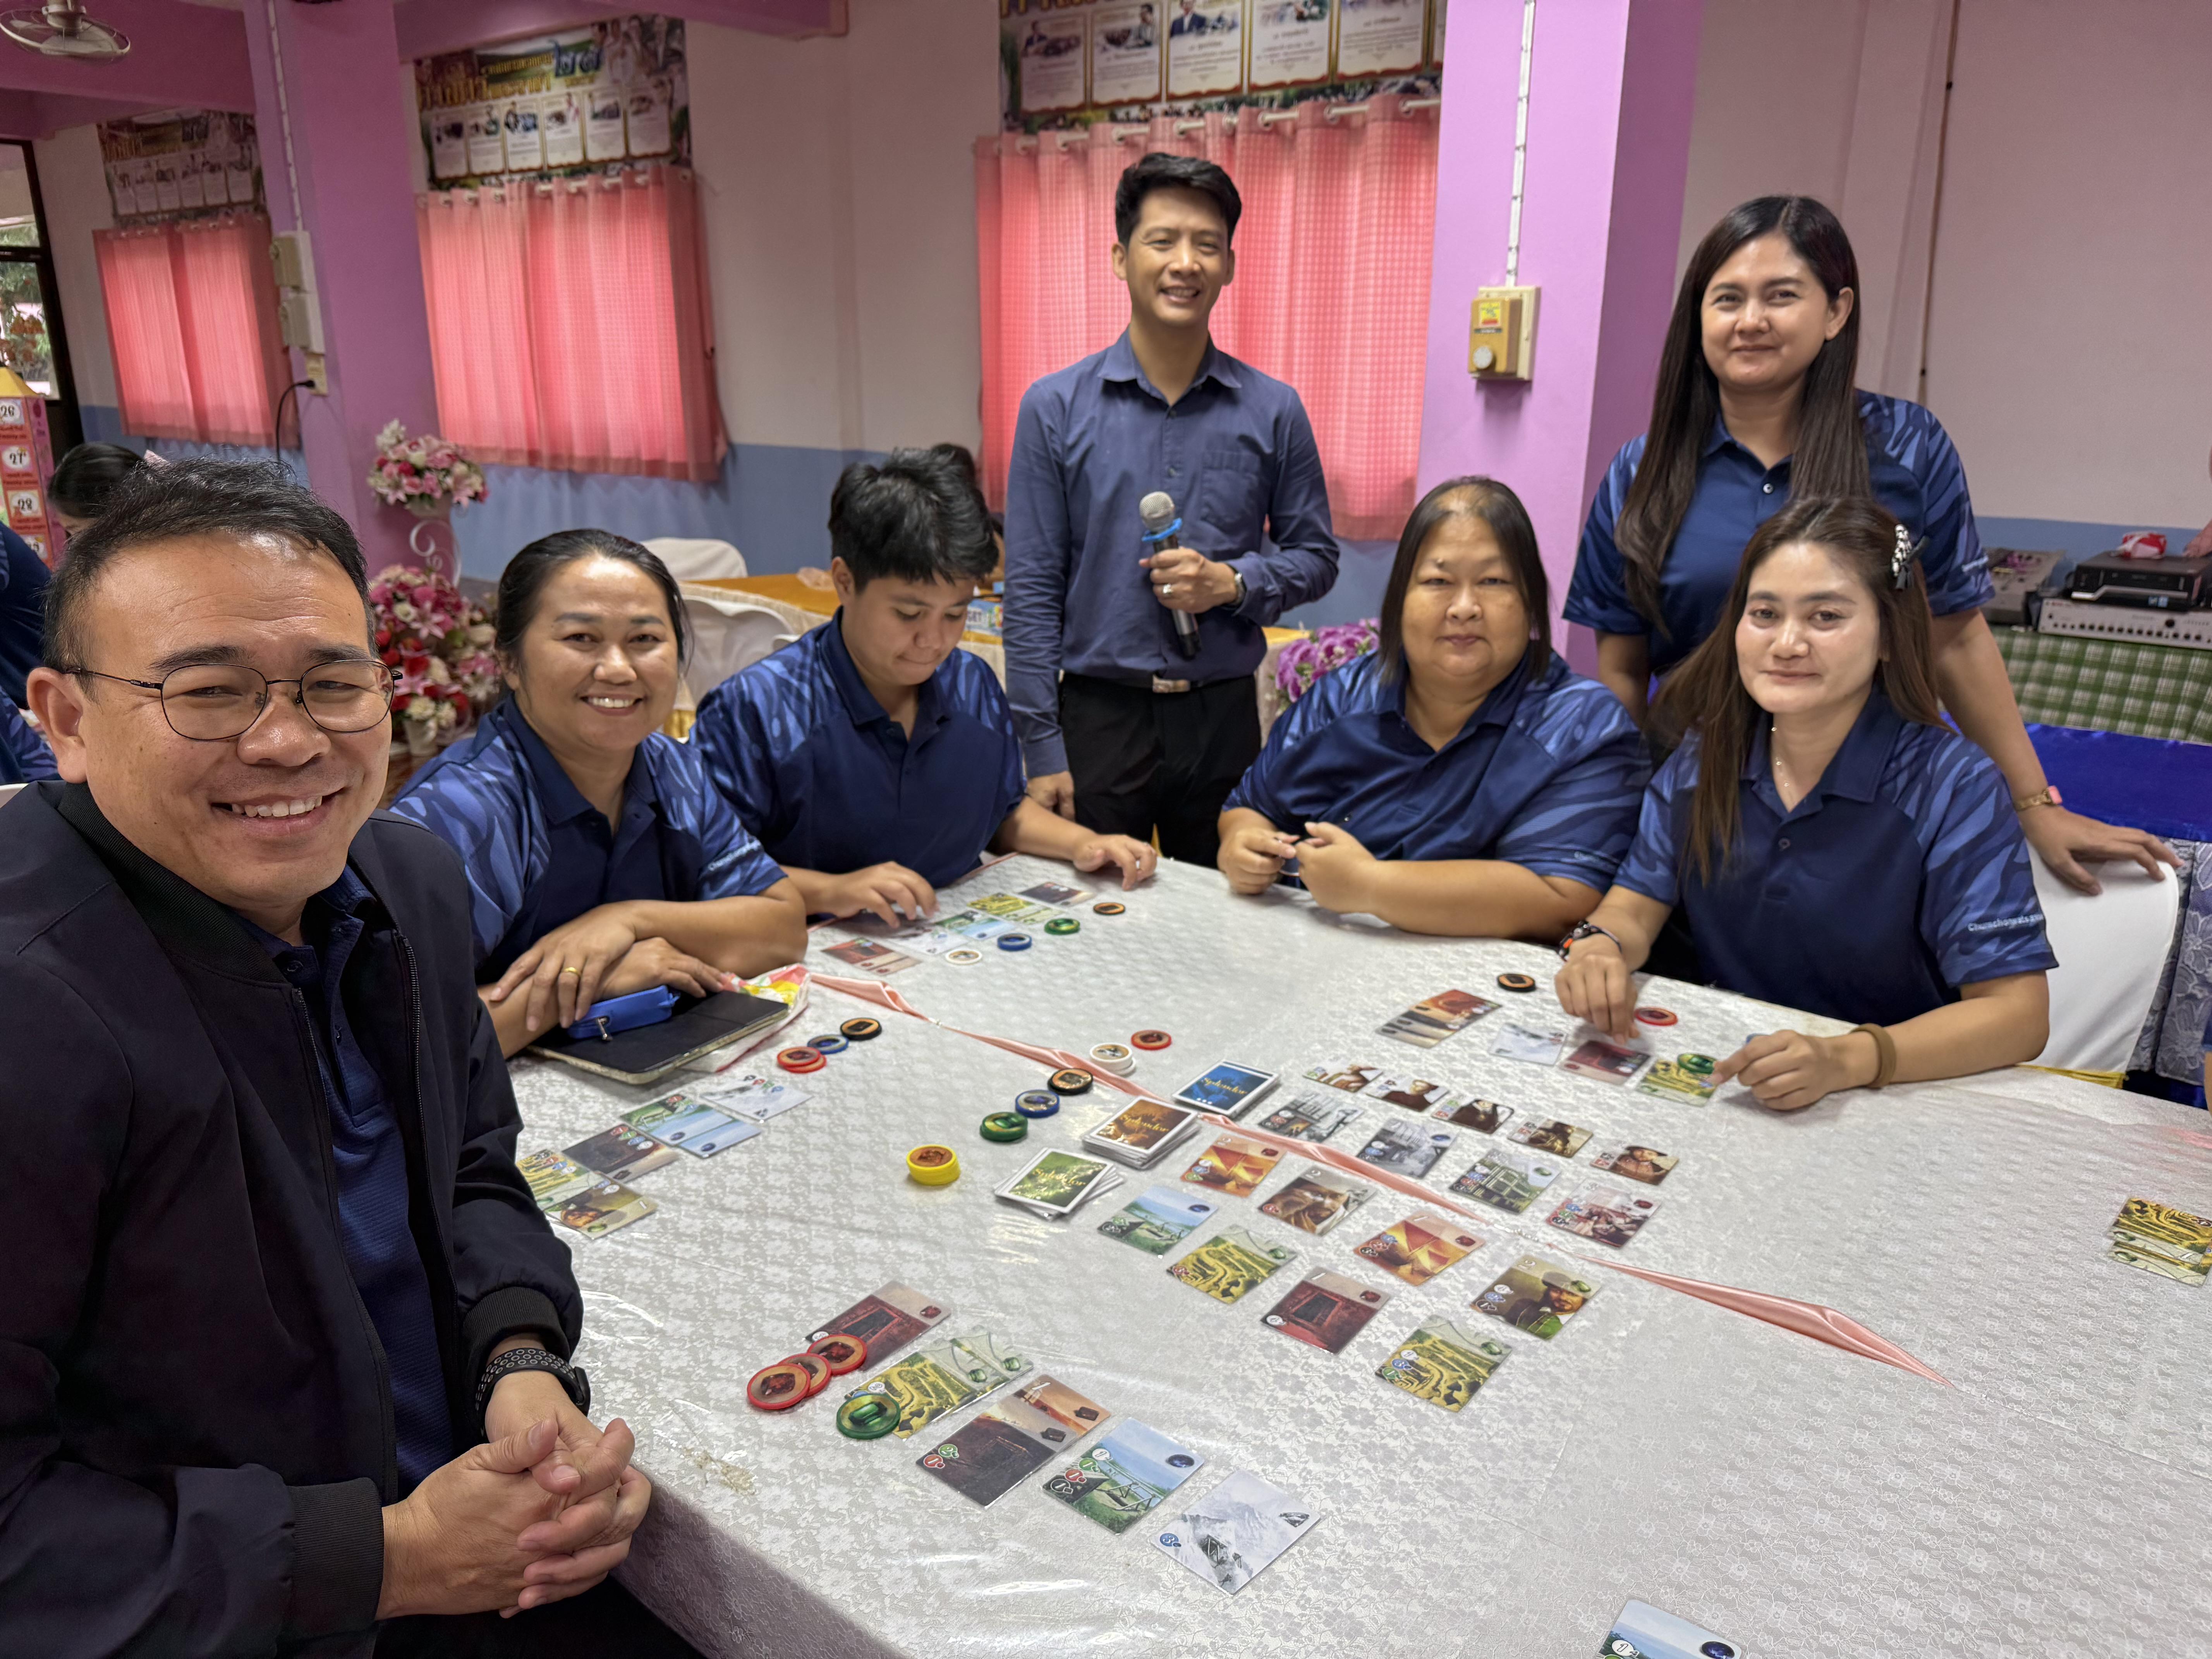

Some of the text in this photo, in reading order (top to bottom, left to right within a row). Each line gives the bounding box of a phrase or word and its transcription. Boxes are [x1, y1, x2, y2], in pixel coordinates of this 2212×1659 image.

[0, 405, 15, 417] 26
[17, 498, 32, 510] 28
[1201, 1078, 1247, 1095] Splendor
[1119, 1114, 1169, 1132] Splendor
[1305, 1170, 1321, 1179] 2
[639, 1200, 647, 1209] 1
[1518, 1260, 1536, 1269] 2
[1031, 1382, 1051, 1390] 1
[1616, 1643, 1629, 1652] 1
